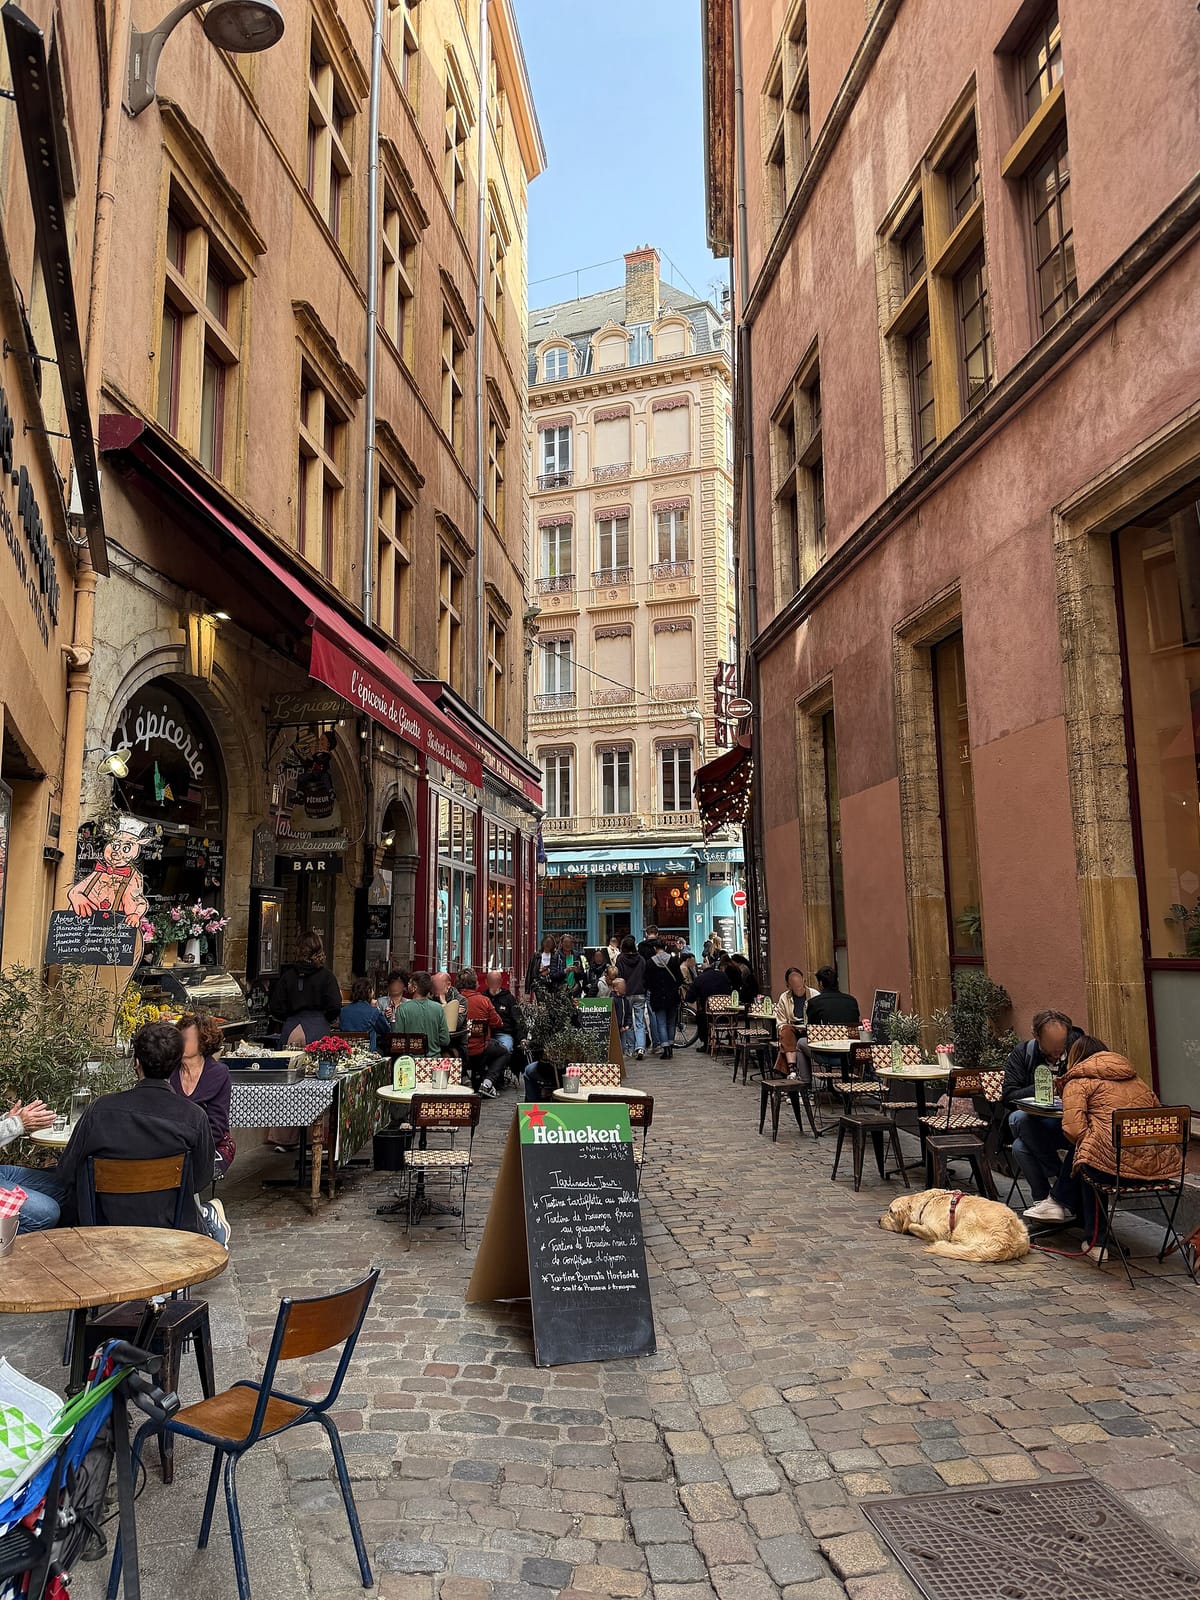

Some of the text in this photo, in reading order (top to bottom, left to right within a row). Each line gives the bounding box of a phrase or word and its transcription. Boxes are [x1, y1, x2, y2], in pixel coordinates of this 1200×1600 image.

[351, 669, 388, 716] l'épicerie
[388, 700, 398, 724] de
[280, 838, 347, 852] restaurant
[293, 861, 326, 871] BAR
[532, 1125, 621, 1144] Heineken
[572, 1210, 582, 1222] de
[576, 1237, 583, 1250] de
[586, 1236, 610, 1248] boudin
[552, 1254, 560, 1266] de
[546, 1272, 576, 1283] Tartine
[574, 1271, 605, 1282] Burrata
